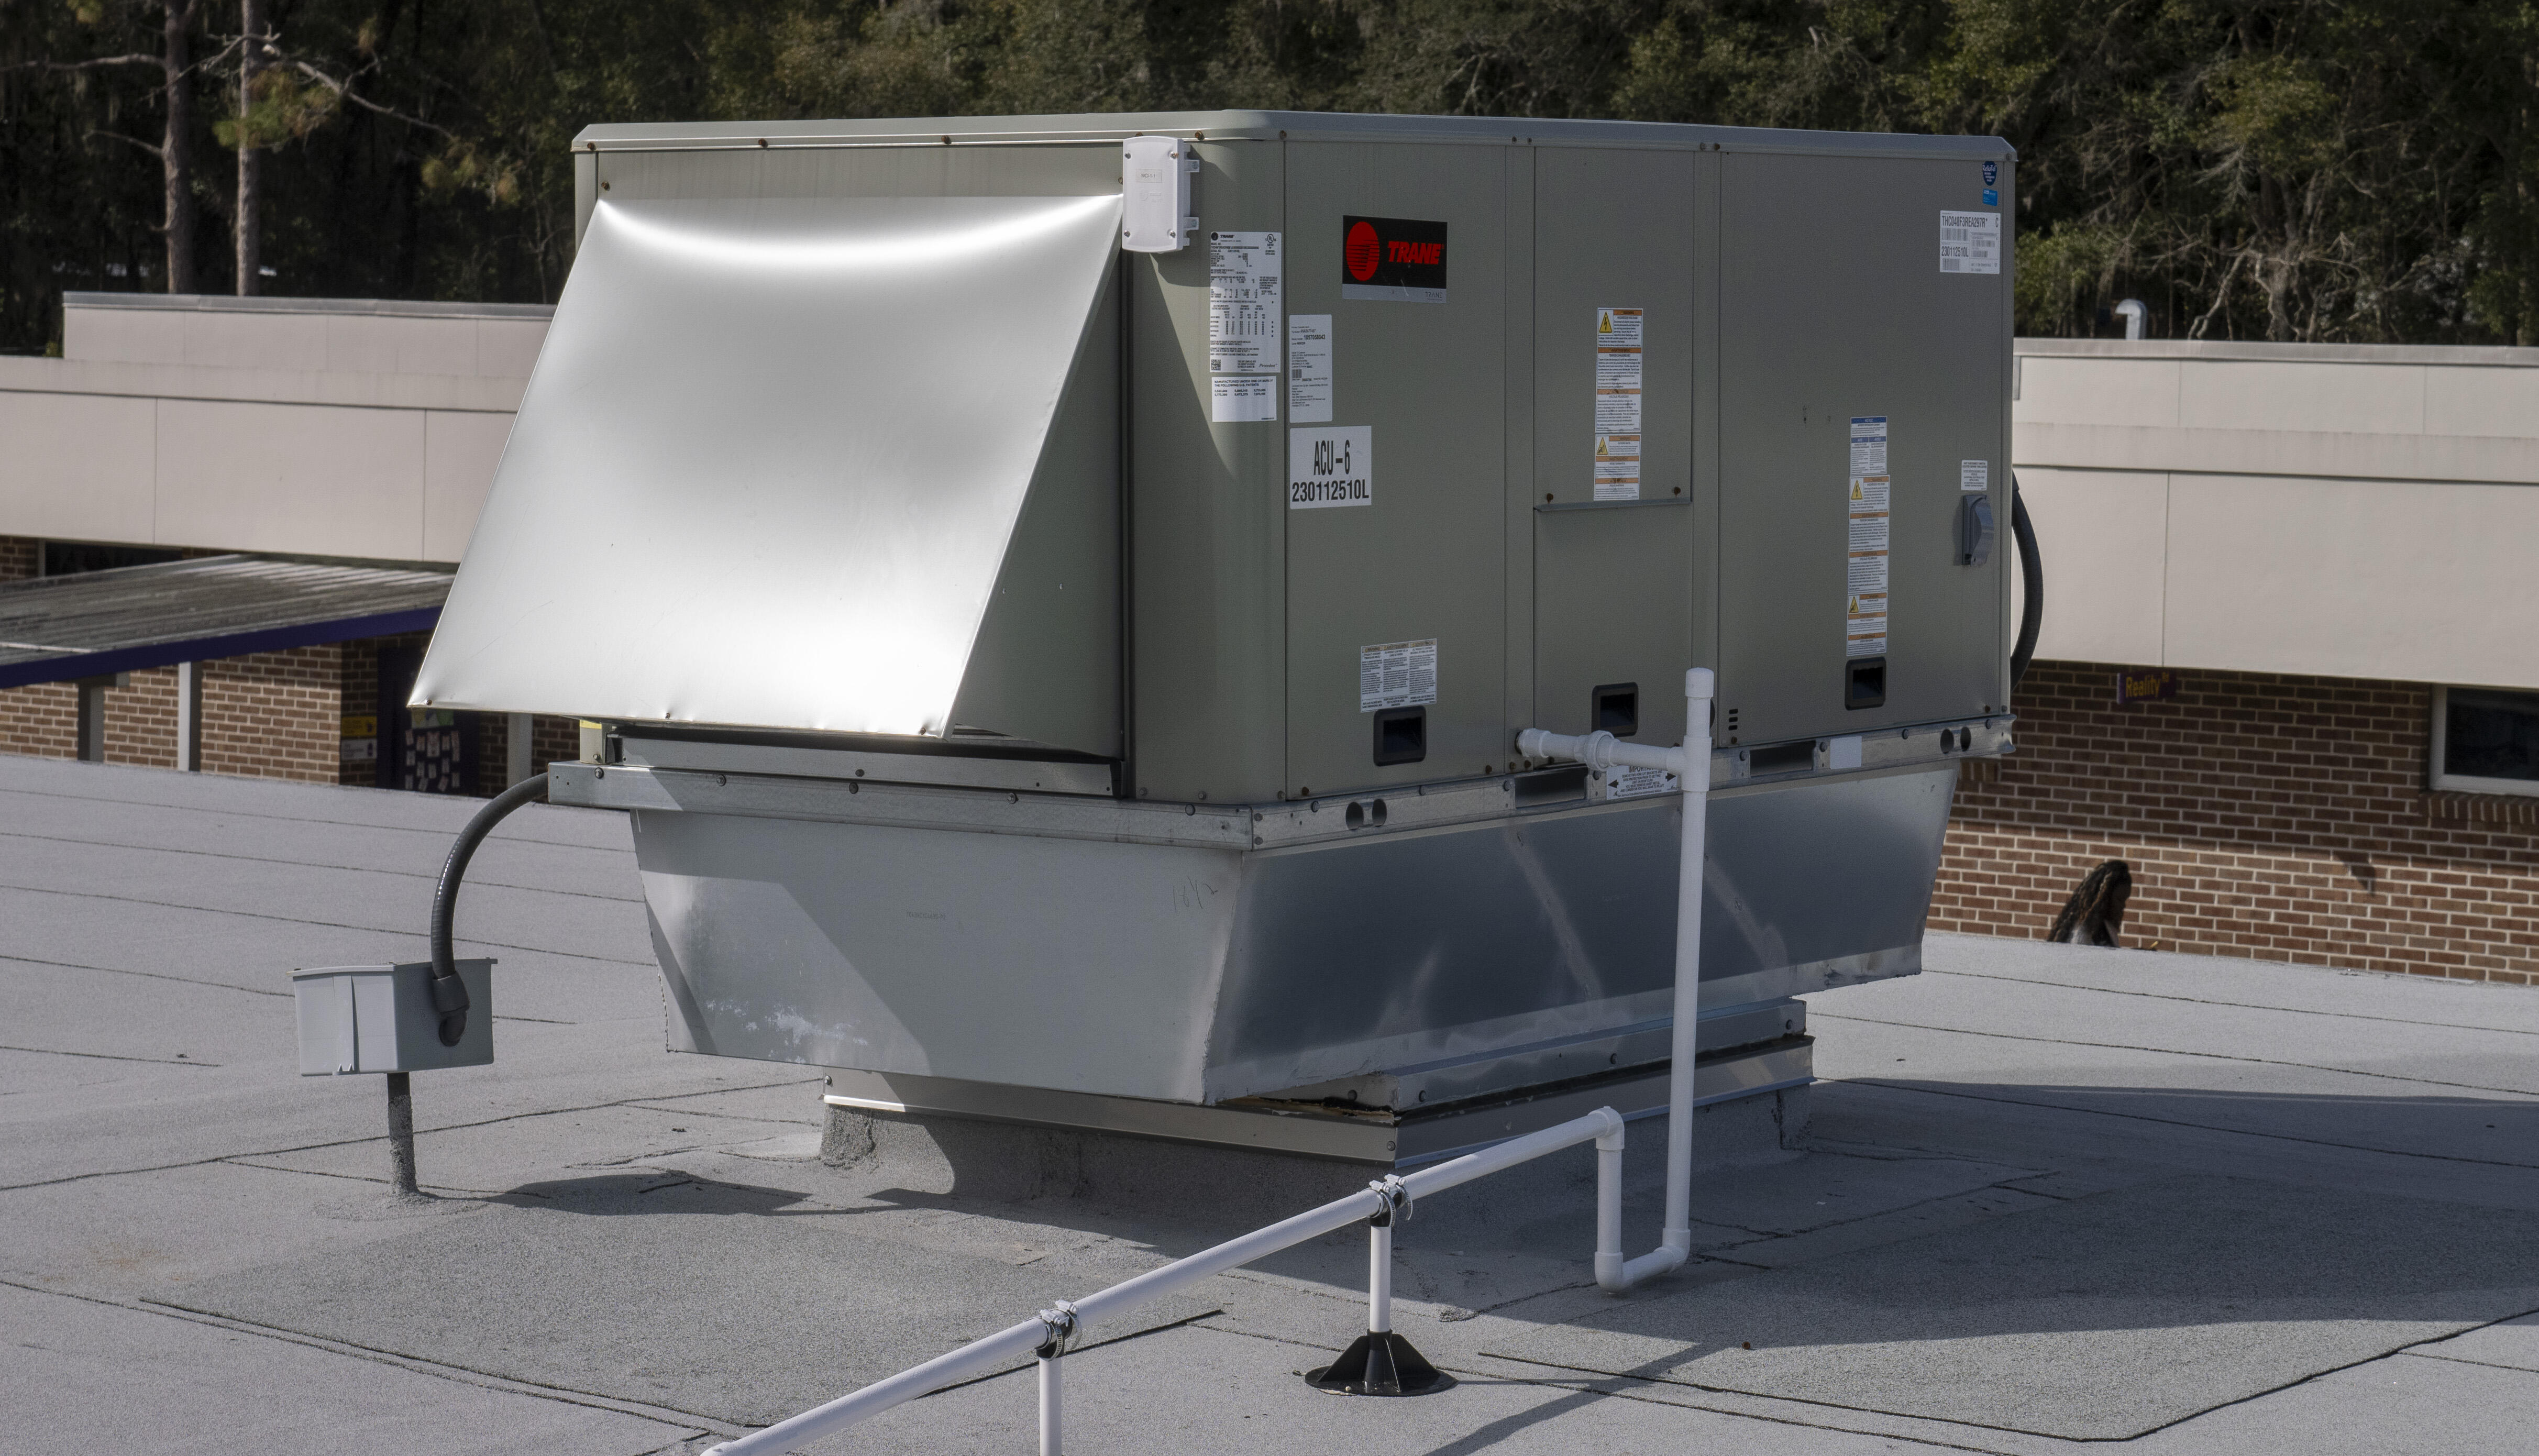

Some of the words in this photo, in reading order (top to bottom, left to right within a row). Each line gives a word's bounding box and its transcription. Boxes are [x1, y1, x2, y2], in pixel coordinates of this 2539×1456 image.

[1995, 217, 1999, 228] C
[1388, 241, 1441, 264] TRANE
[1941, 246, 1969, 257] 230112510L
[1292, 479, 1370, 502] 230112510L
[2126, 674, 2160, 698] Reality
